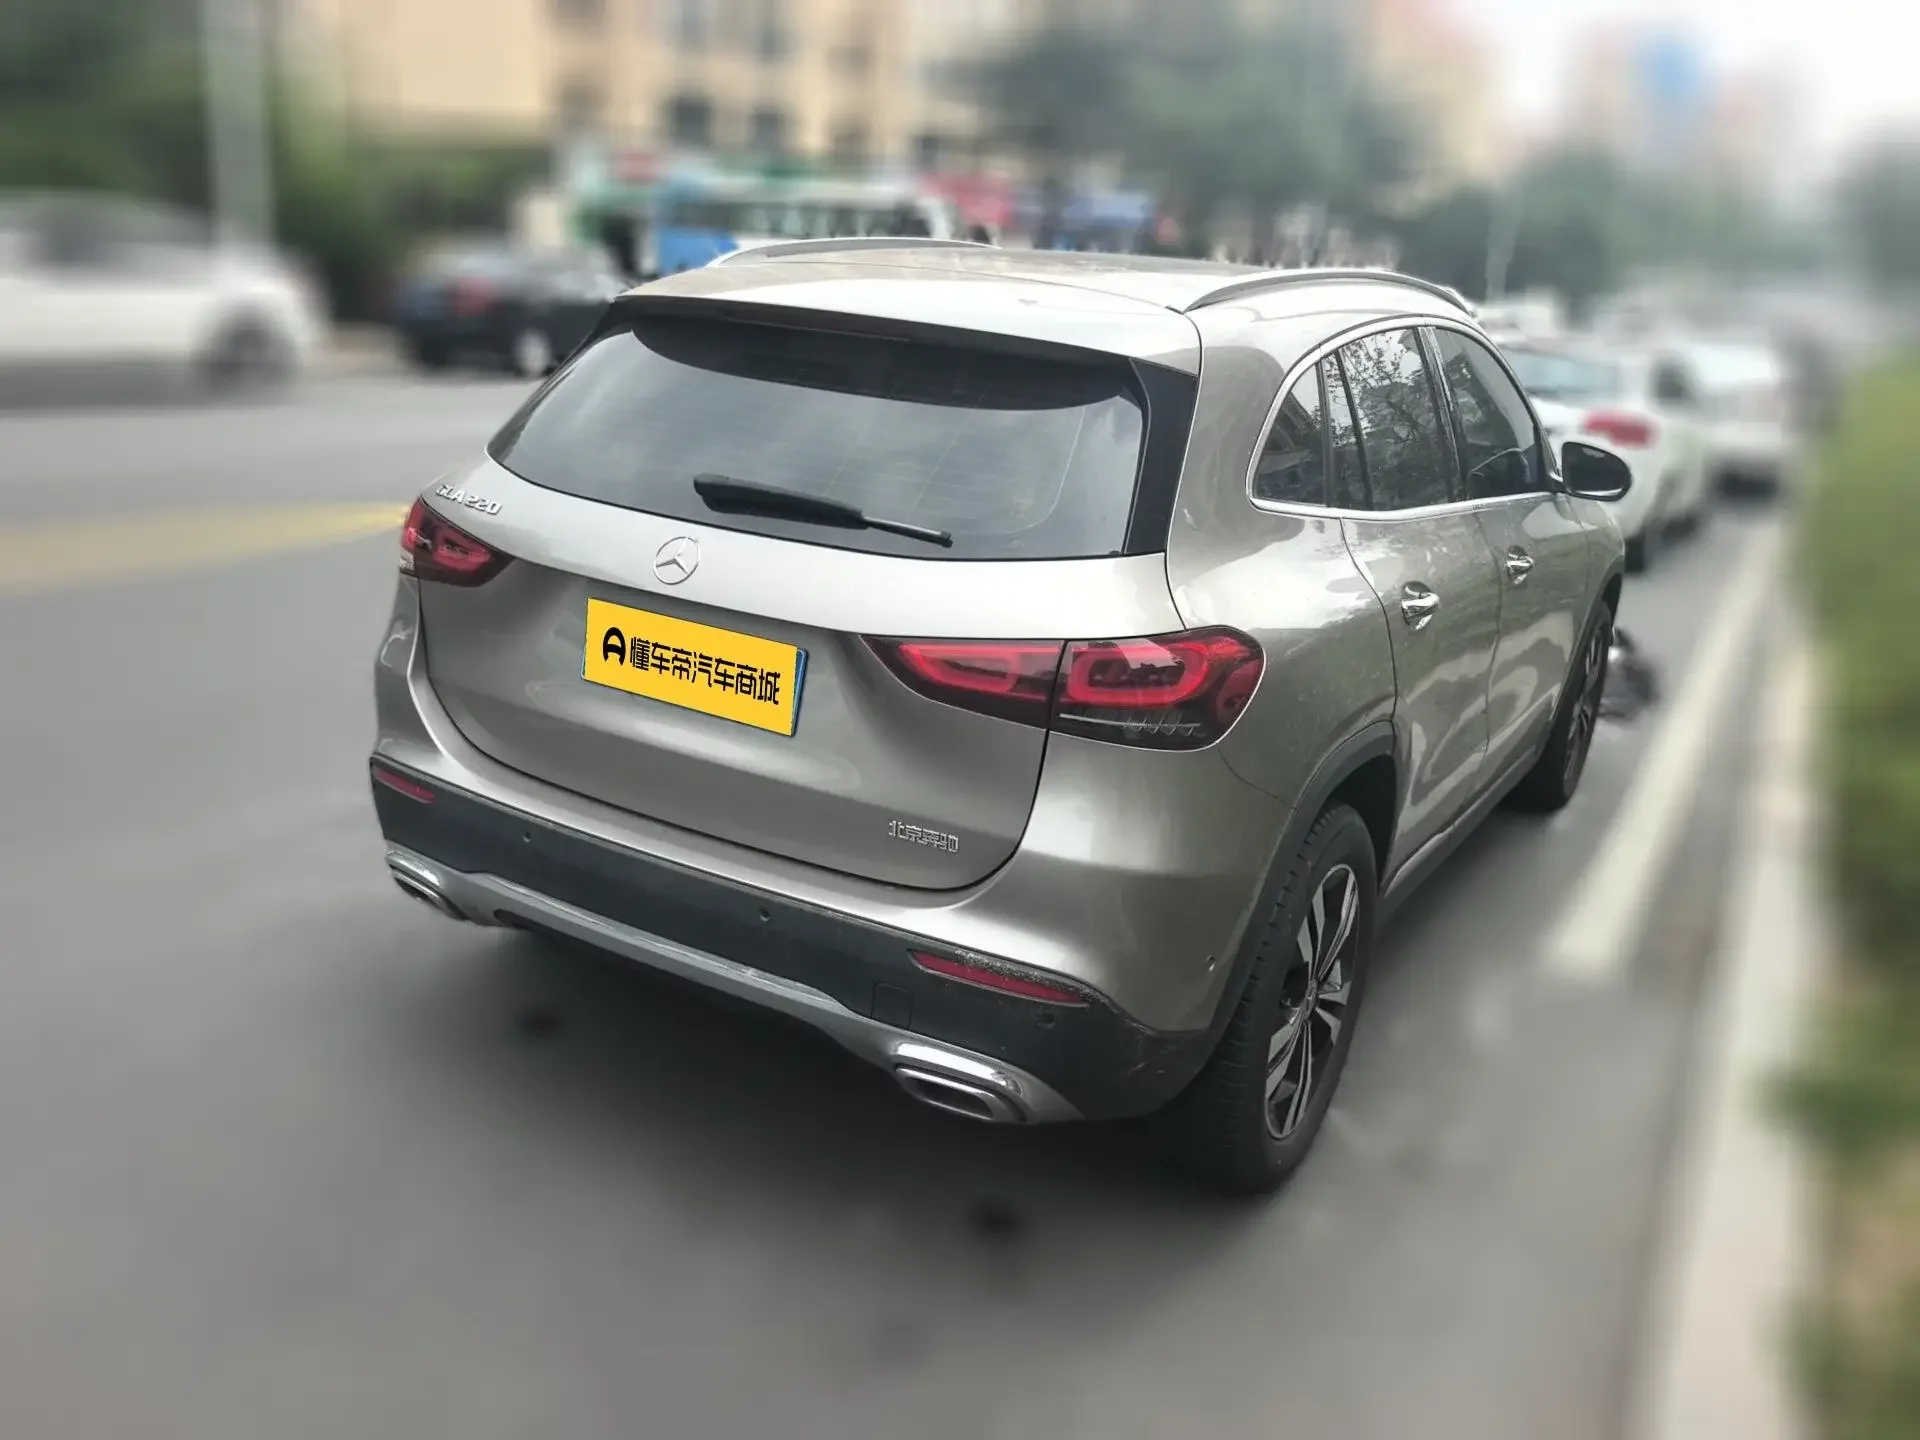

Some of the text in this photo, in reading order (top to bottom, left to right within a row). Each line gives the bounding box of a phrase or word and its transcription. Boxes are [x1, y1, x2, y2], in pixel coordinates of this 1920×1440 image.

[436, 484, 502, 515] GLA 220
[888, 820, 959, 853] 北京奔驰
